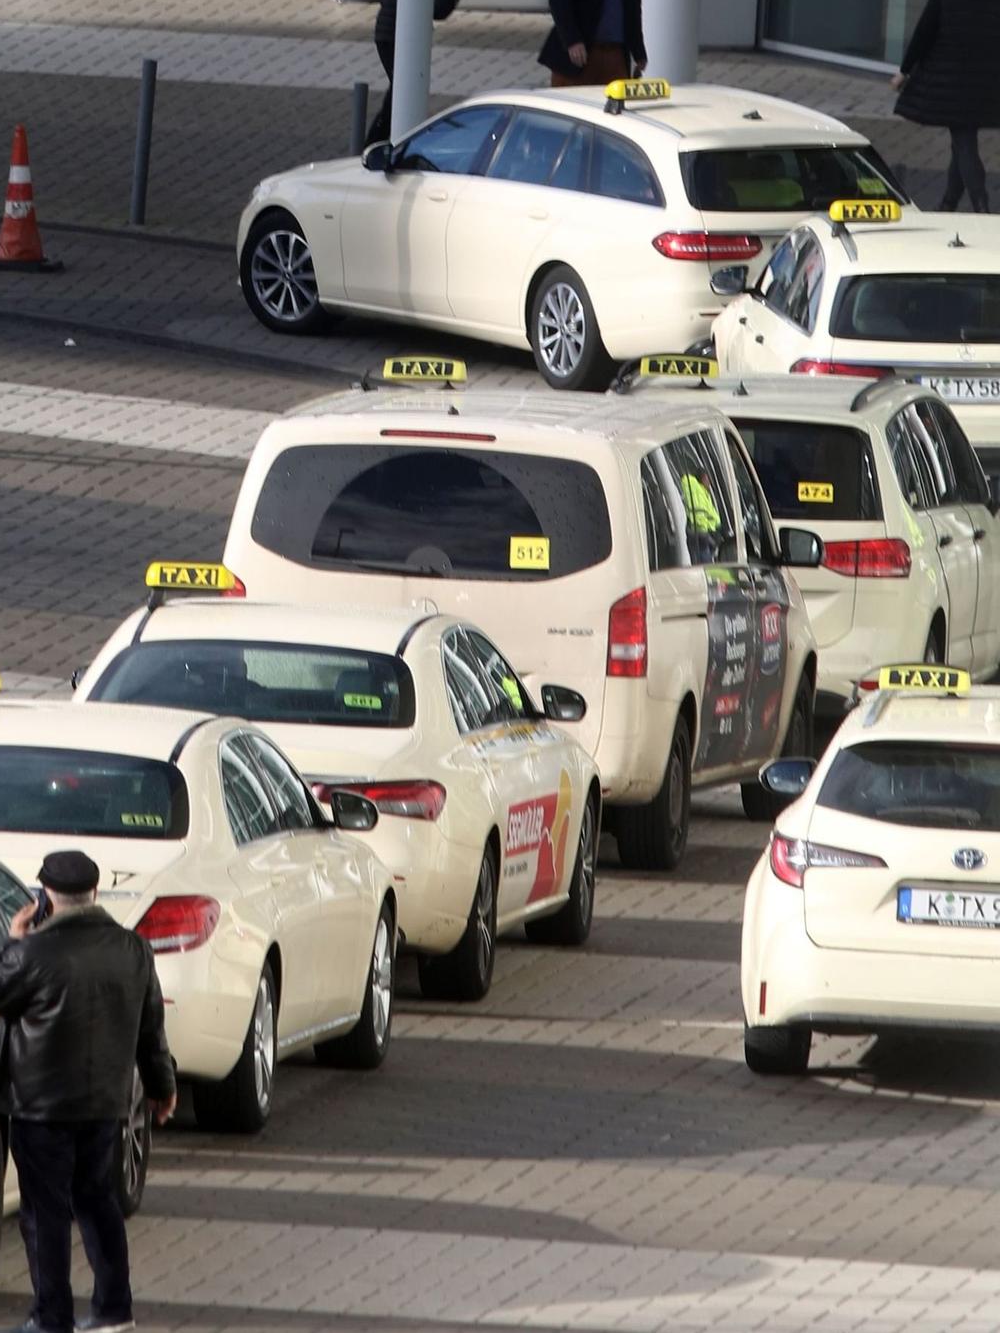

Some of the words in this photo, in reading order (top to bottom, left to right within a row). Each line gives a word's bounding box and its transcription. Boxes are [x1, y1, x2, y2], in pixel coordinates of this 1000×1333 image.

[626, 83, 664, 97] TAXI
[845, 205, 890, 219] TAXI
[401, 362, 446, 376] TAXI
[658, 359, 704, 374] TAXI
[953, 379, 976, 397] TX
[799, 485, 831, 498] 474
[516, 545, 544, 561] 512
[162, 567, 219, 586] TAXI
[901, 669, 951, 687] TAXI
[928, 893, 941, 916] K
[959, 896, 985, 919] TX
